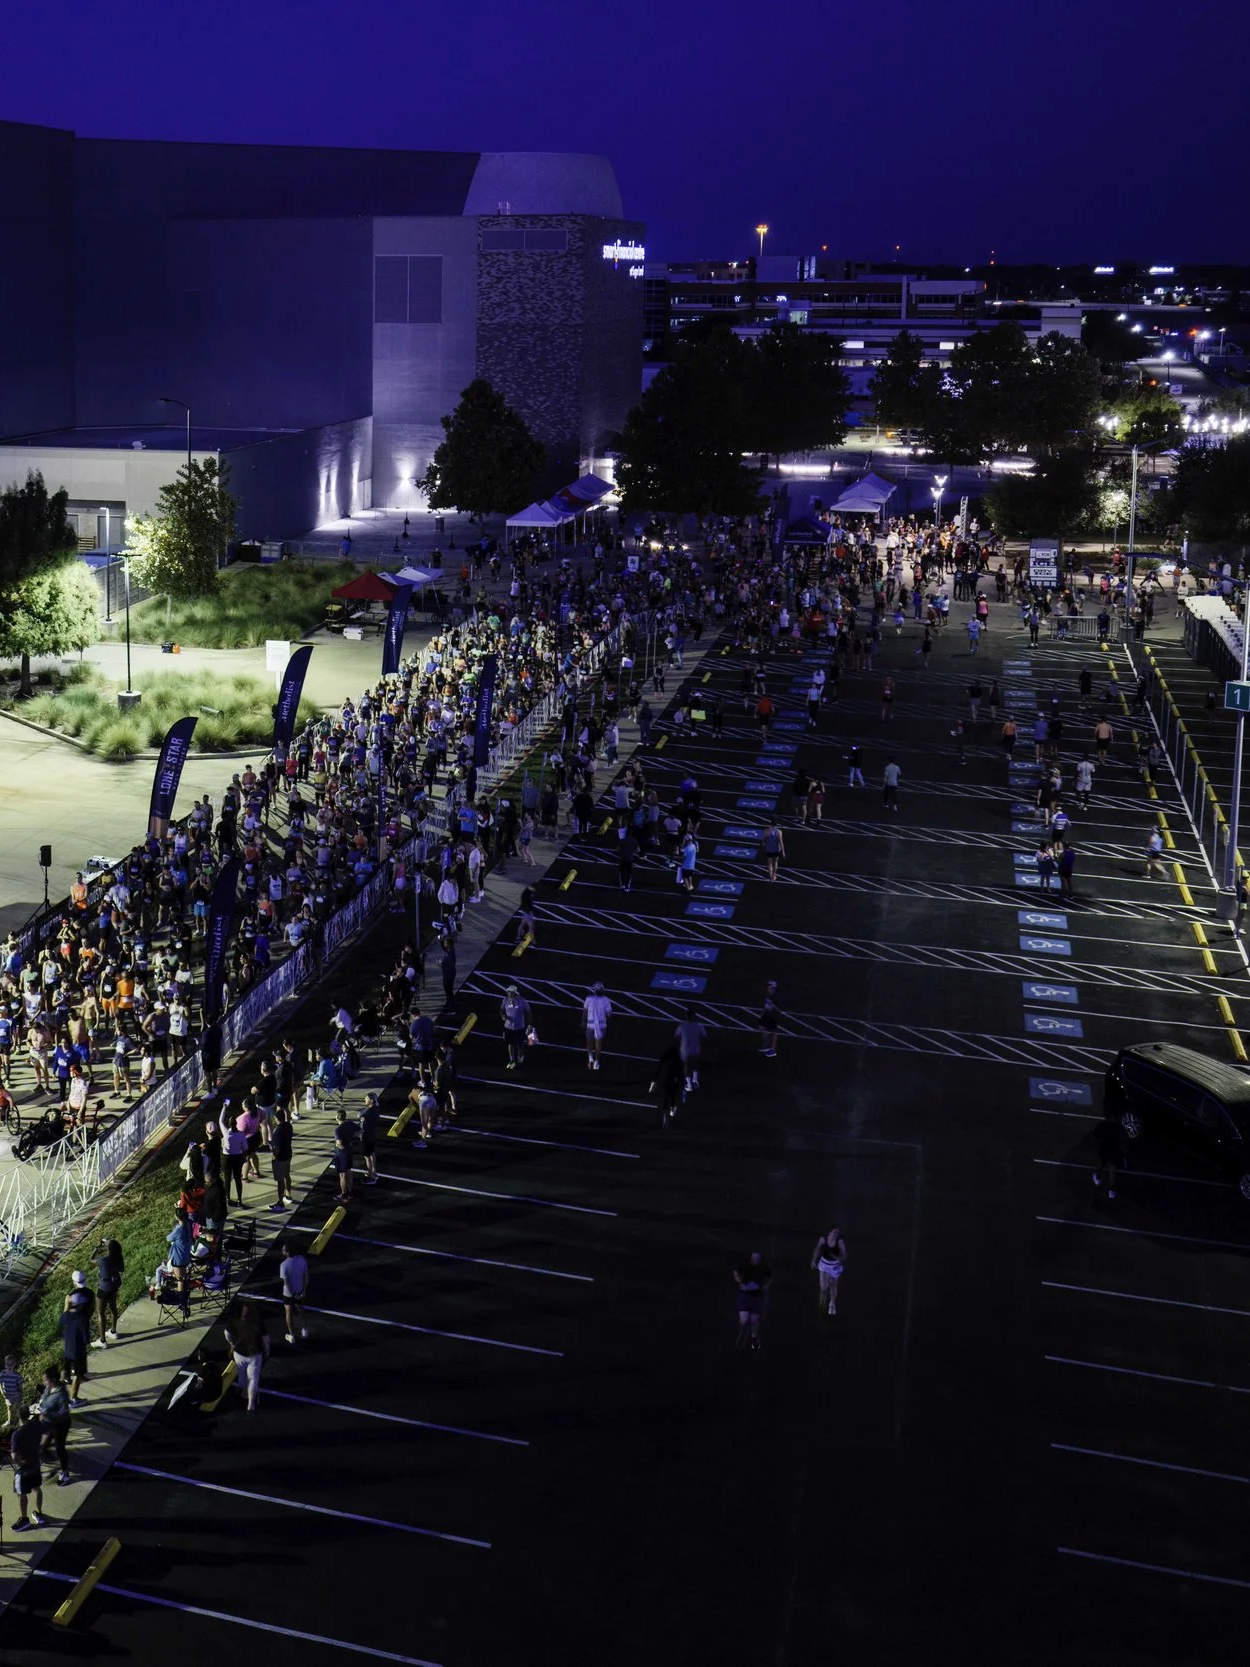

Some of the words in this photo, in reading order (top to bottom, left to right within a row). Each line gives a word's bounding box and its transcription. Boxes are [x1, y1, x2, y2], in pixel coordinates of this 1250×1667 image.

[280, 680, 296, 722] Methodist
[1234, 688, 1241, 704] 1
[166, 737, 183, 764] STAR
[159, 770, 174, 795] LONE
